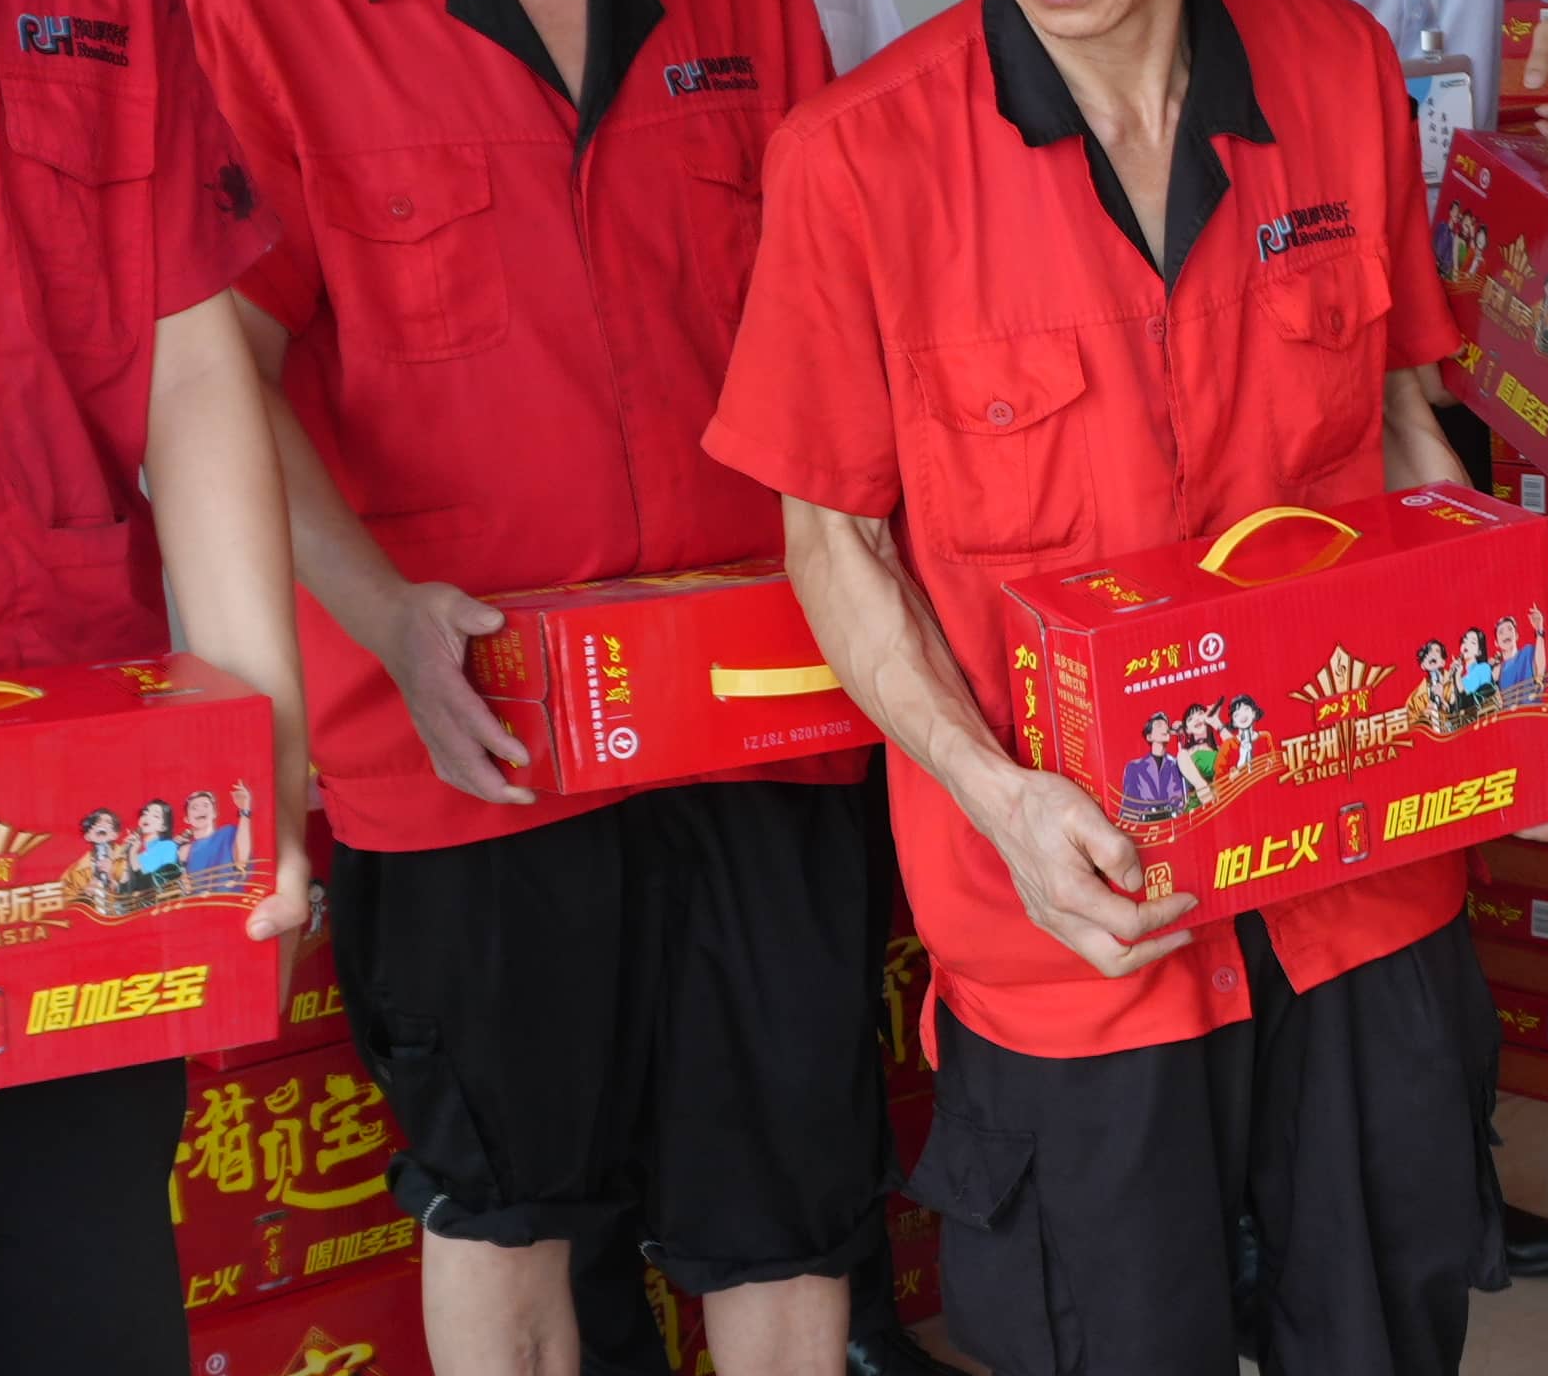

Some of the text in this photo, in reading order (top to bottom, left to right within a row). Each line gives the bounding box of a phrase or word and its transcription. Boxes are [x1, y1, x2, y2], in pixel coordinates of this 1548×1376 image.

[1352, 746, 1399, 770] ASIA
[1212, 767, 1518, 891] 怕上火 喝加多宝
[24, 963, 211, 1036] 喝加多宝
[303, 1216, 417, 1276] 喝加多宝
